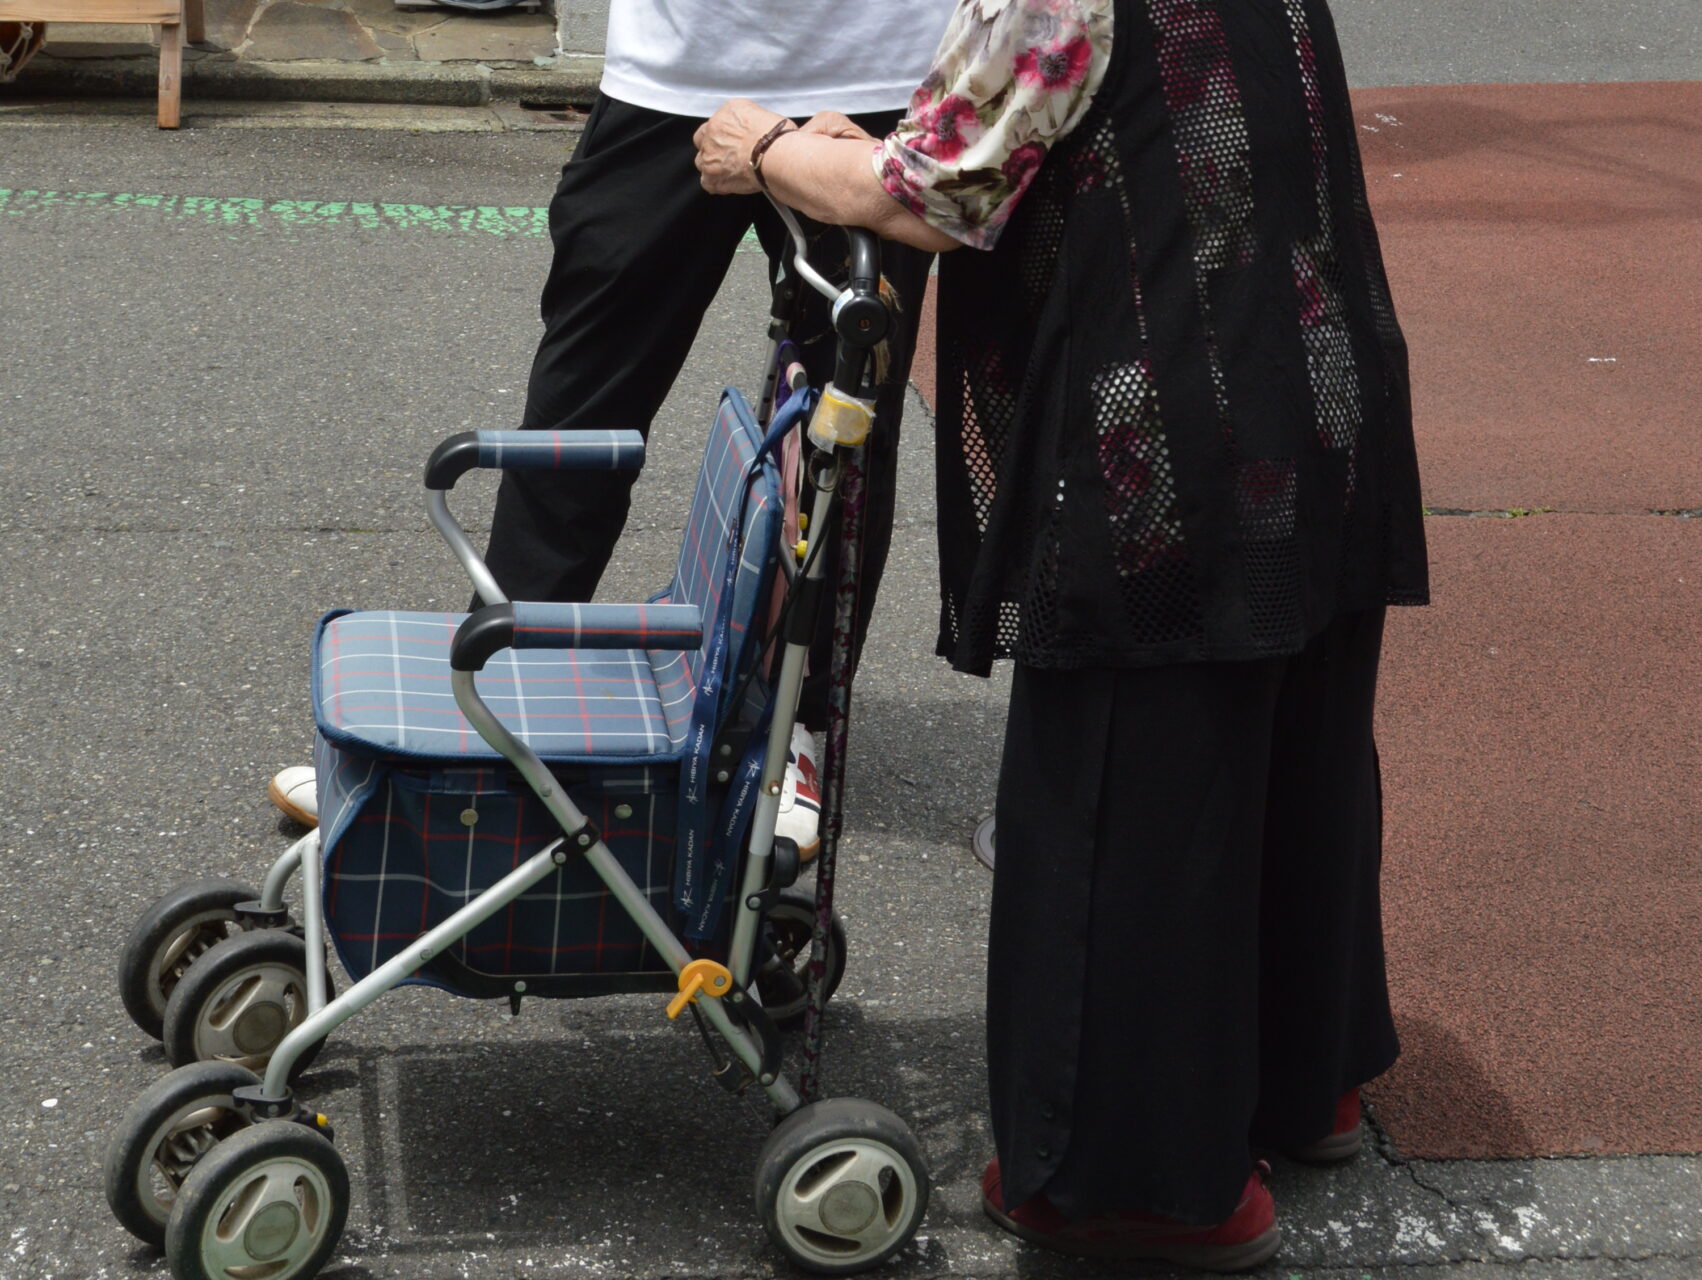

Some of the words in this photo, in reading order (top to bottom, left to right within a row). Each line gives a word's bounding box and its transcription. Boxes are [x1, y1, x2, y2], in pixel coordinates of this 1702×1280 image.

[711, 647, 722, 674] HIBIYA
[694, 724, 705, 755] KADAN
[690, 756, 699, 784] HIBIYA
[739, 780, 750, 807] HIBIYA
[726, 808, 741, 837] KADAN
[685, 860, 694, 886] HIBIYA
